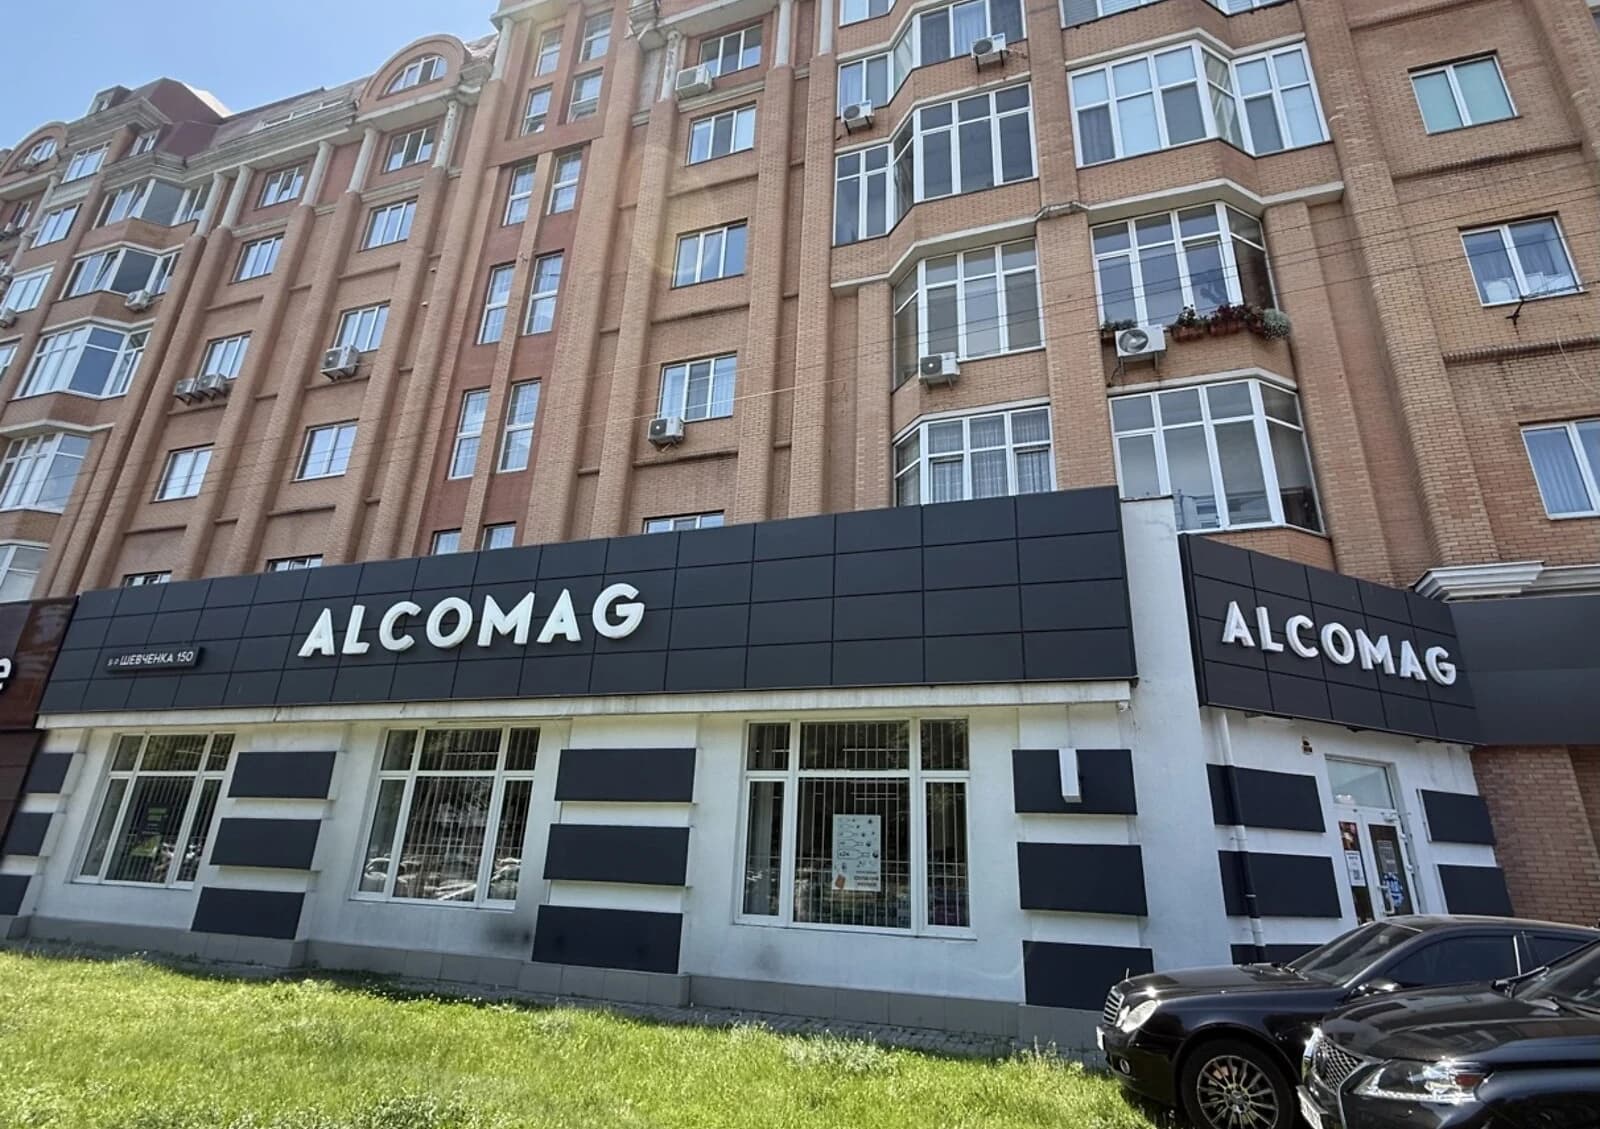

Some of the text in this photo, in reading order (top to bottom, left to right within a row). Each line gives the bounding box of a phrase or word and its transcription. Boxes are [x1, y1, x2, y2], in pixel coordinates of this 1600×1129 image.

[298, 583, 645, 657] ALCOMAG
[1222, 600, 1457, 685] ALCOMAG
[120, 653, 173, 666] ШЕВЧЕНКА
[177, 651, 194, 662] 150
